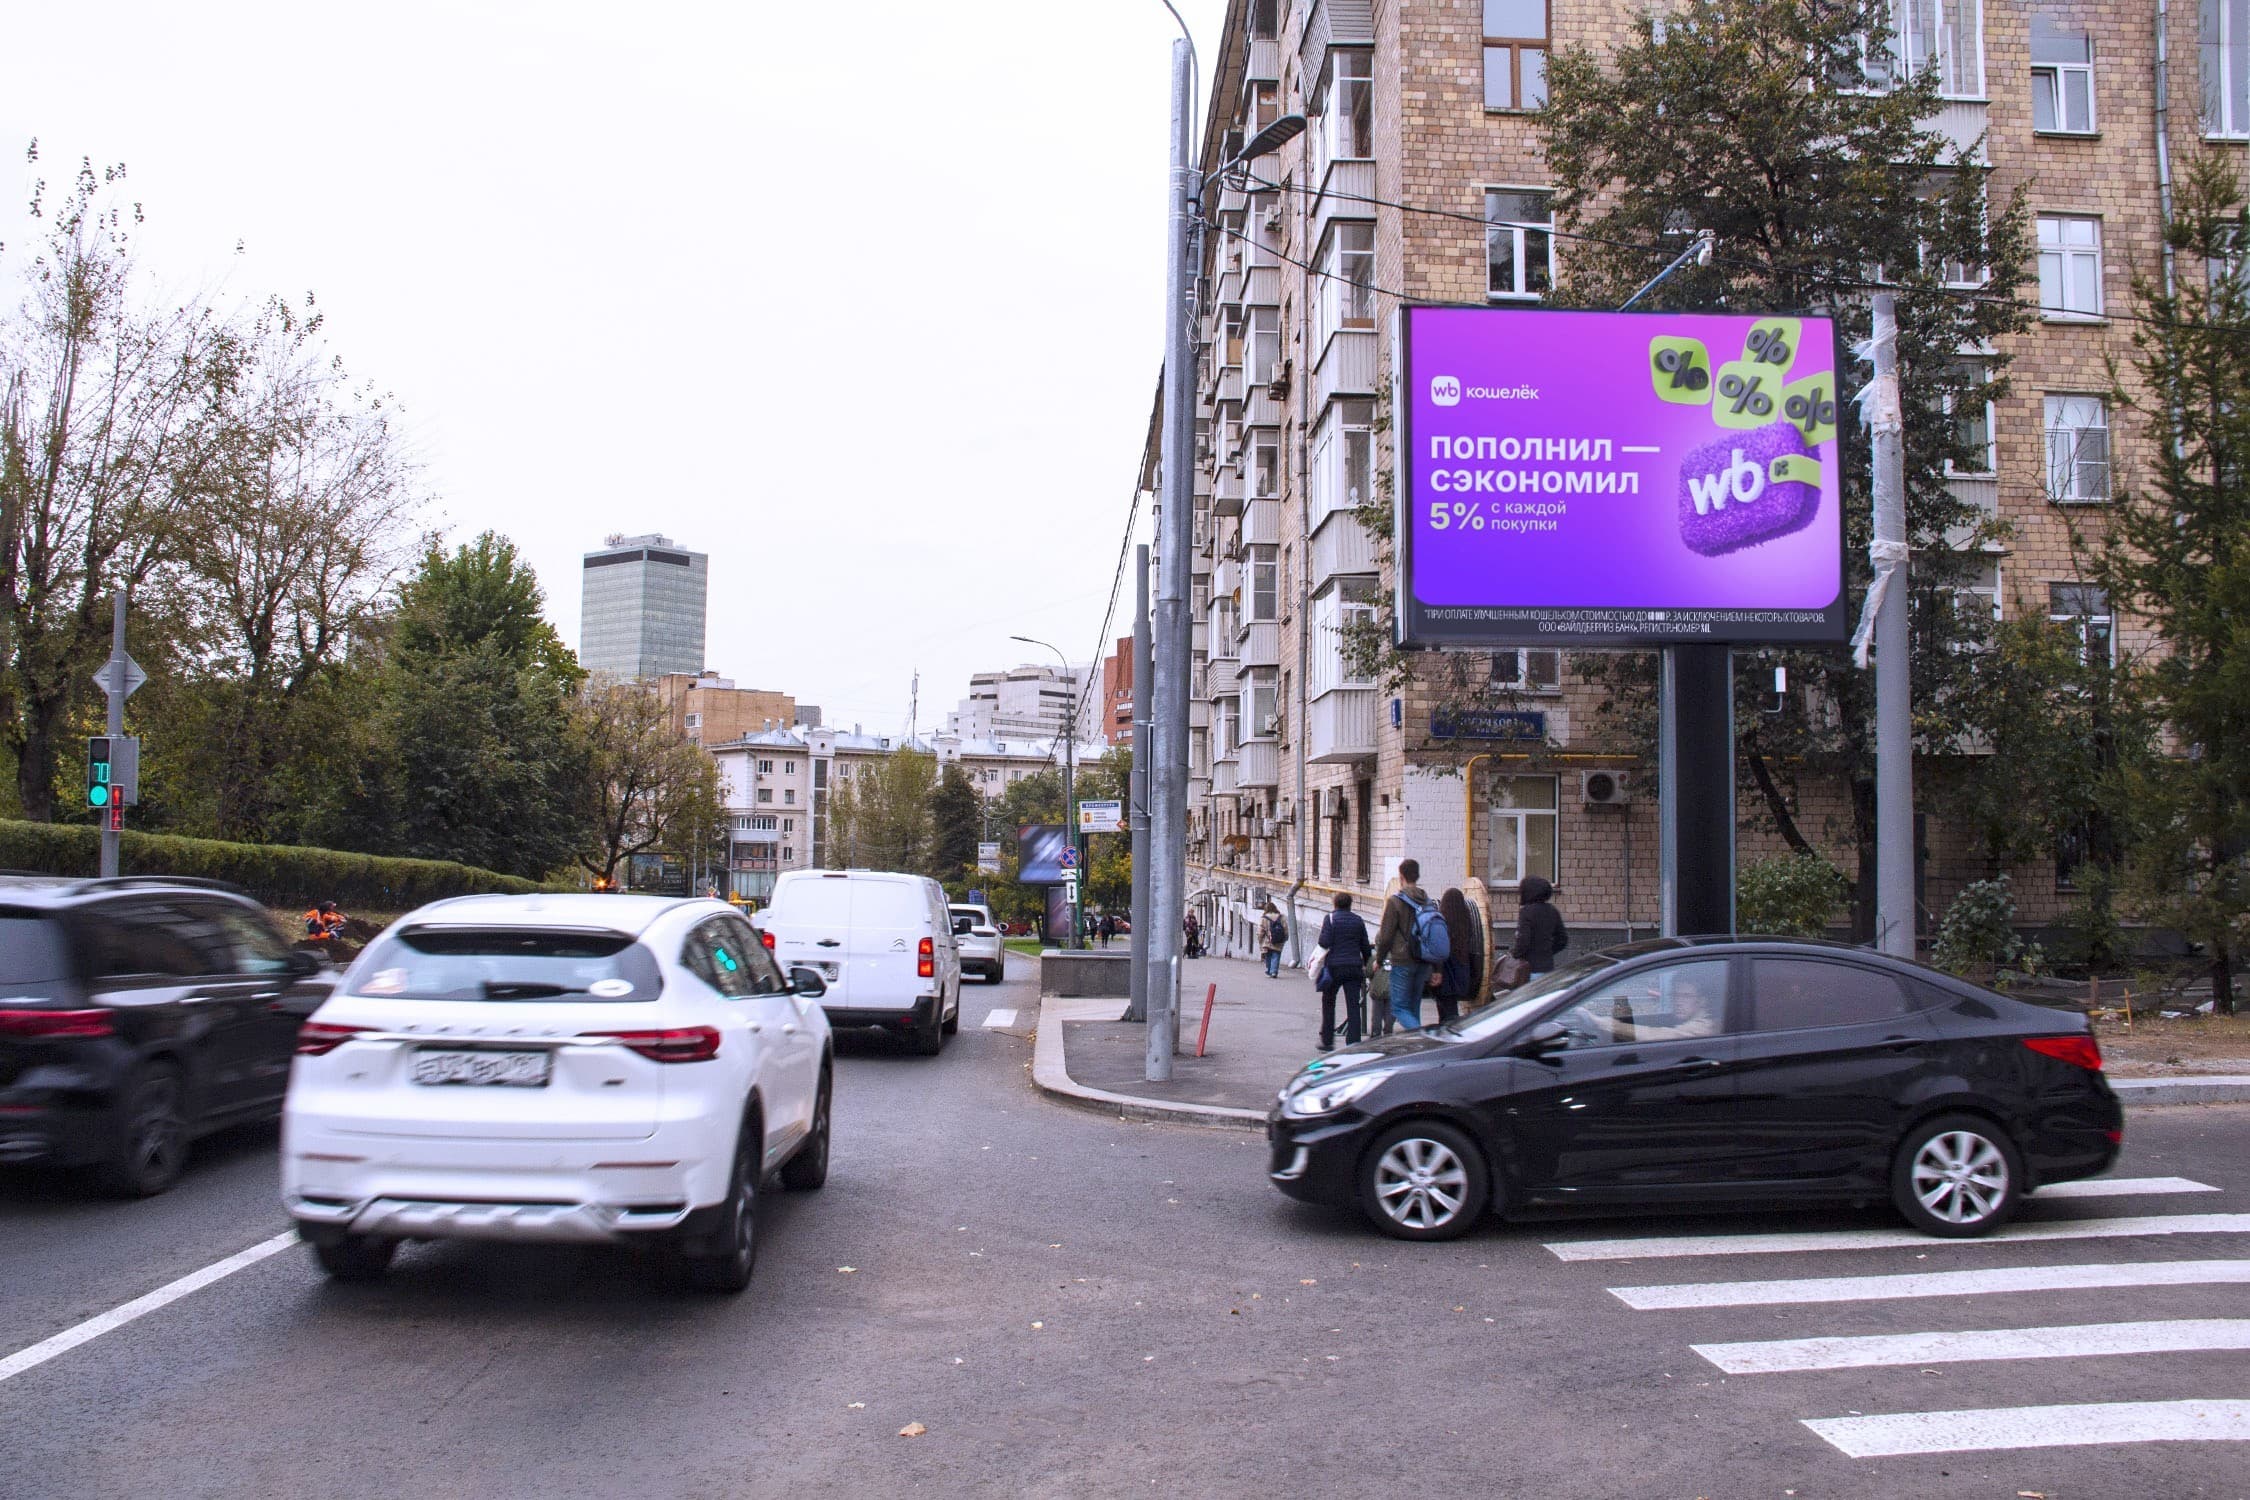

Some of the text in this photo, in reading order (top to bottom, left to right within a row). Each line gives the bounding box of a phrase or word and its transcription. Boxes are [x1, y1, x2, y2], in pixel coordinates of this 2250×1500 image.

[1433, 381, 1540, 400] wb кошелёк
[1687, 448, 1766, 516] wb
[1429, 502, 1485, 531] 5%
[1491, 500, 1567, 517] с каждой
[1491, 519, 1558, 534] покупки
[1444, 609, 1473, 620] ОПЛАТЕ
[1683, 611, 1743, 622] ИСКЛЮЧЕНИЕМ
[1538, 621, 1556, 632] ООО
